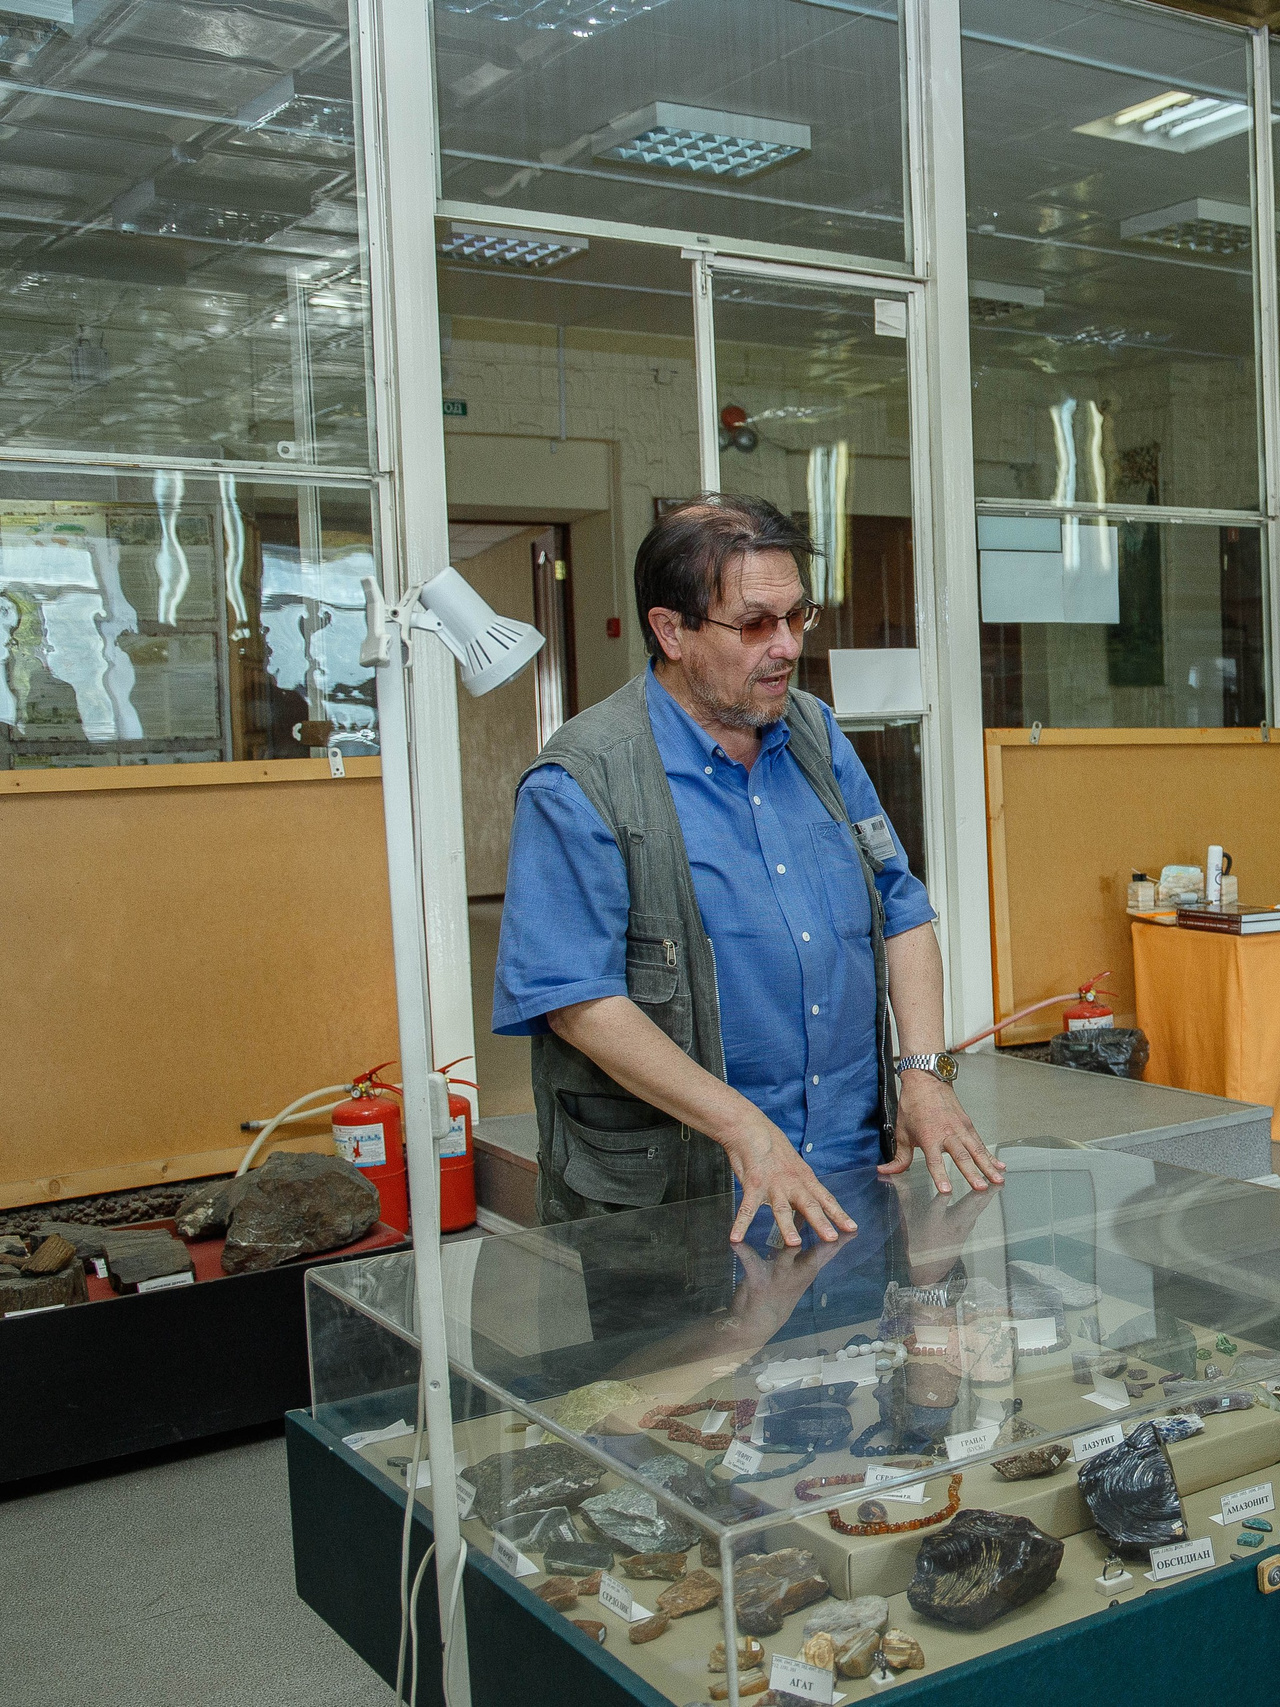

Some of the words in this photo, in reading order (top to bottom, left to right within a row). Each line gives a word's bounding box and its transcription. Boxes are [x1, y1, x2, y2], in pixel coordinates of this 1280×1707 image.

[960, 1435, 987, 1447] ГРАНАТ
[1081, 1434, 1115, 1452] ЛАЗУРИТ
[1226, 1495, 1269, 1515] АМАЗОНИТ
[1156, 1549, 1211, 1570] ОБСИДИАН
[602, 1591, 629, 1614] СЕРДОЛИК
[789, 1678, 814, 1691] АГАТ
